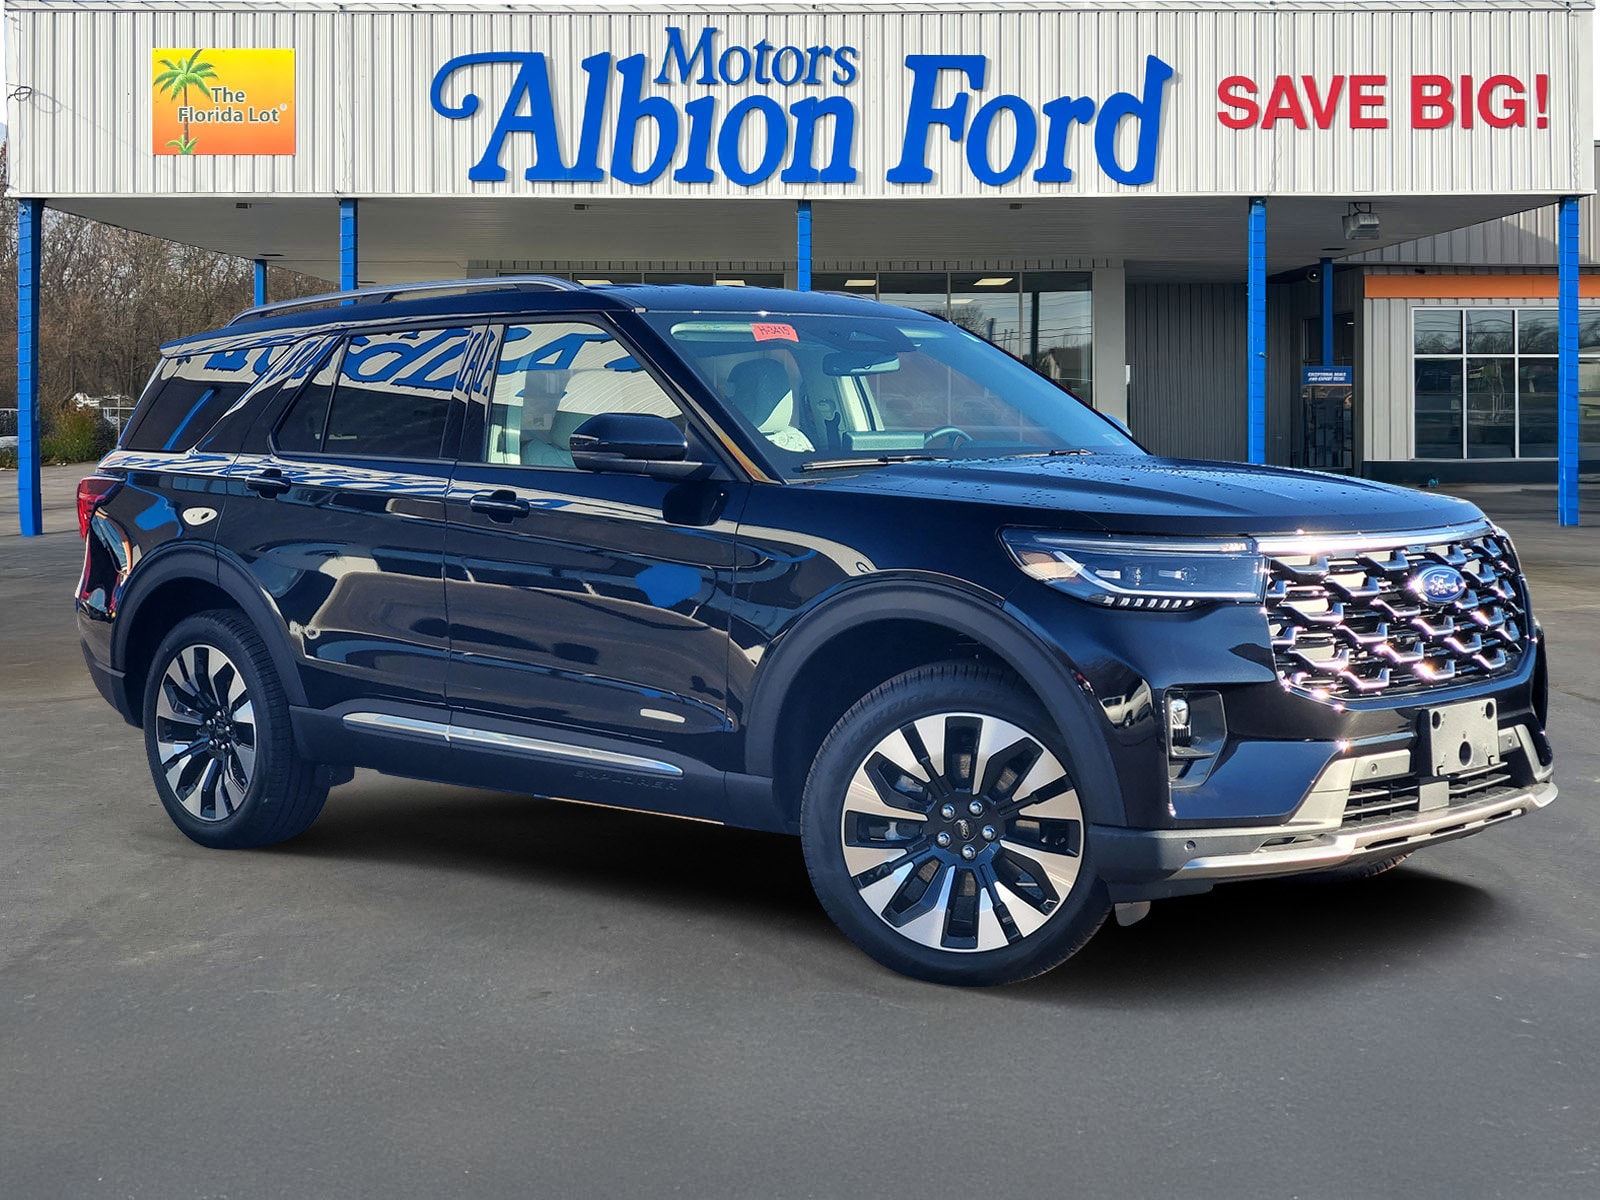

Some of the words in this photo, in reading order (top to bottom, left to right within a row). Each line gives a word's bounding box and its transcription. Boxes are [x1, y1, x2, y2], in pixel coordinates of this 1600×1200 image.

[654, 26, 857, 86] Motors
[178, 106, 244, 123] Florida
[211, 87, 246, 103] The
[430, 51, 857, 187] Albion
[887, 54, 1174, 187] Ford
[1217, 75, 1388, 130] SAVE
[1410, 74, 1549, 130] BIG!
